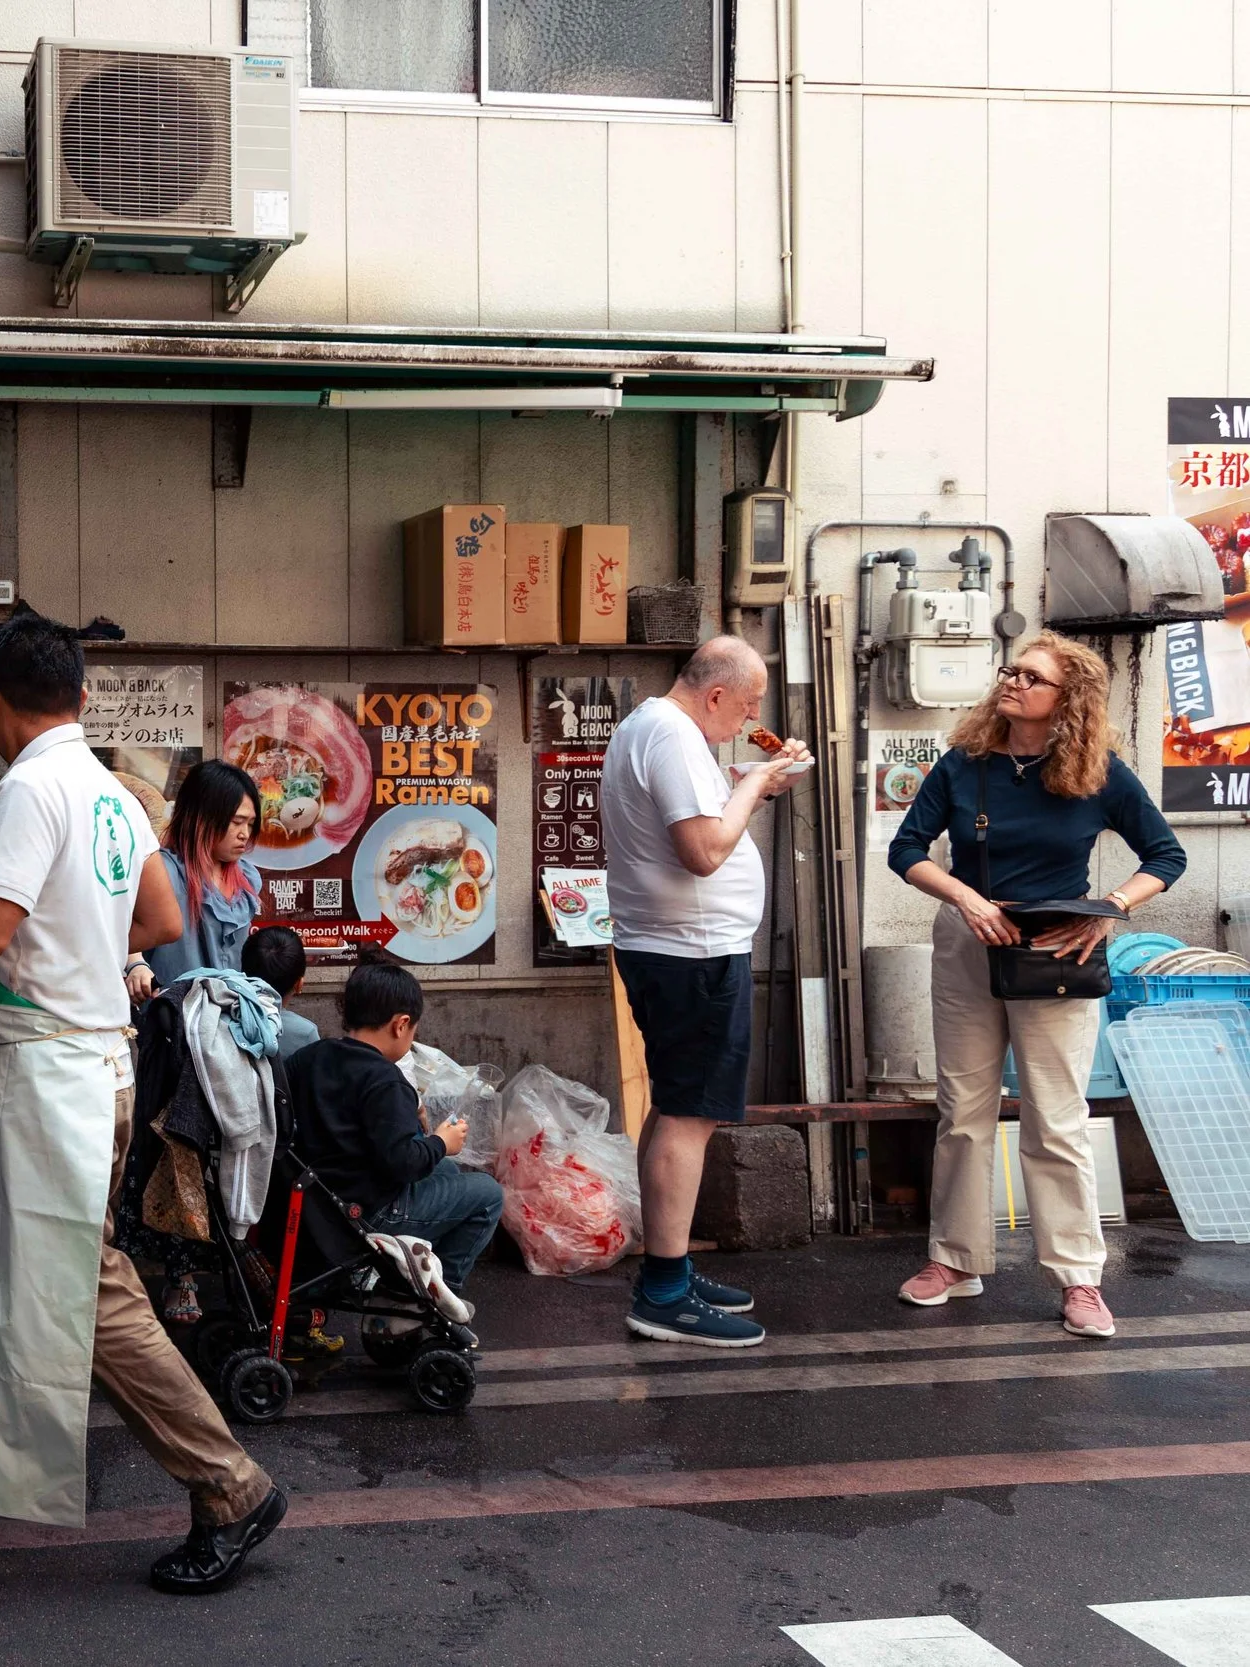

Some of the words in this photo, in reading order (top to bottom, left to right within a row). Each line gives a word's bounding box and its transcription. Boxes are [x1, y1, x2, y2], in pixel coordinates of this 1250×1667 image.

[1233, 405, 1250, 438] M
[97, 680, 126, 692] MOON
[356, 693, 493, 728] KYOTO
[581, 706, 612, 720] MOON
[85, 727, 184, 744] ーメンのお店
[381, 725, 481, 743] 国産黒毛和牛
[885, 738, 905, 749] ALL
[909, 738, 936, 749] TIME
[382, 741, 481, 776] BEST
[881, 747, 941, 768] vegan
[396, 778, 436, 786] PREMIUM
[439, 778, 472, 786] WAGYU
[545, 769, 571, 781] Only
[375, 778, 489, 805] Ramen
[1227, 773, 1250, 806] M
[269, 880, 303, 894] RAMEN
[552, 880, 573, 890] ALL
[574, 877, 603, 888] TIME
[276, 897, 296, 910] BAR
[342, 925, 371, 936] Walk
[330, 953, 358, 962] midnight
